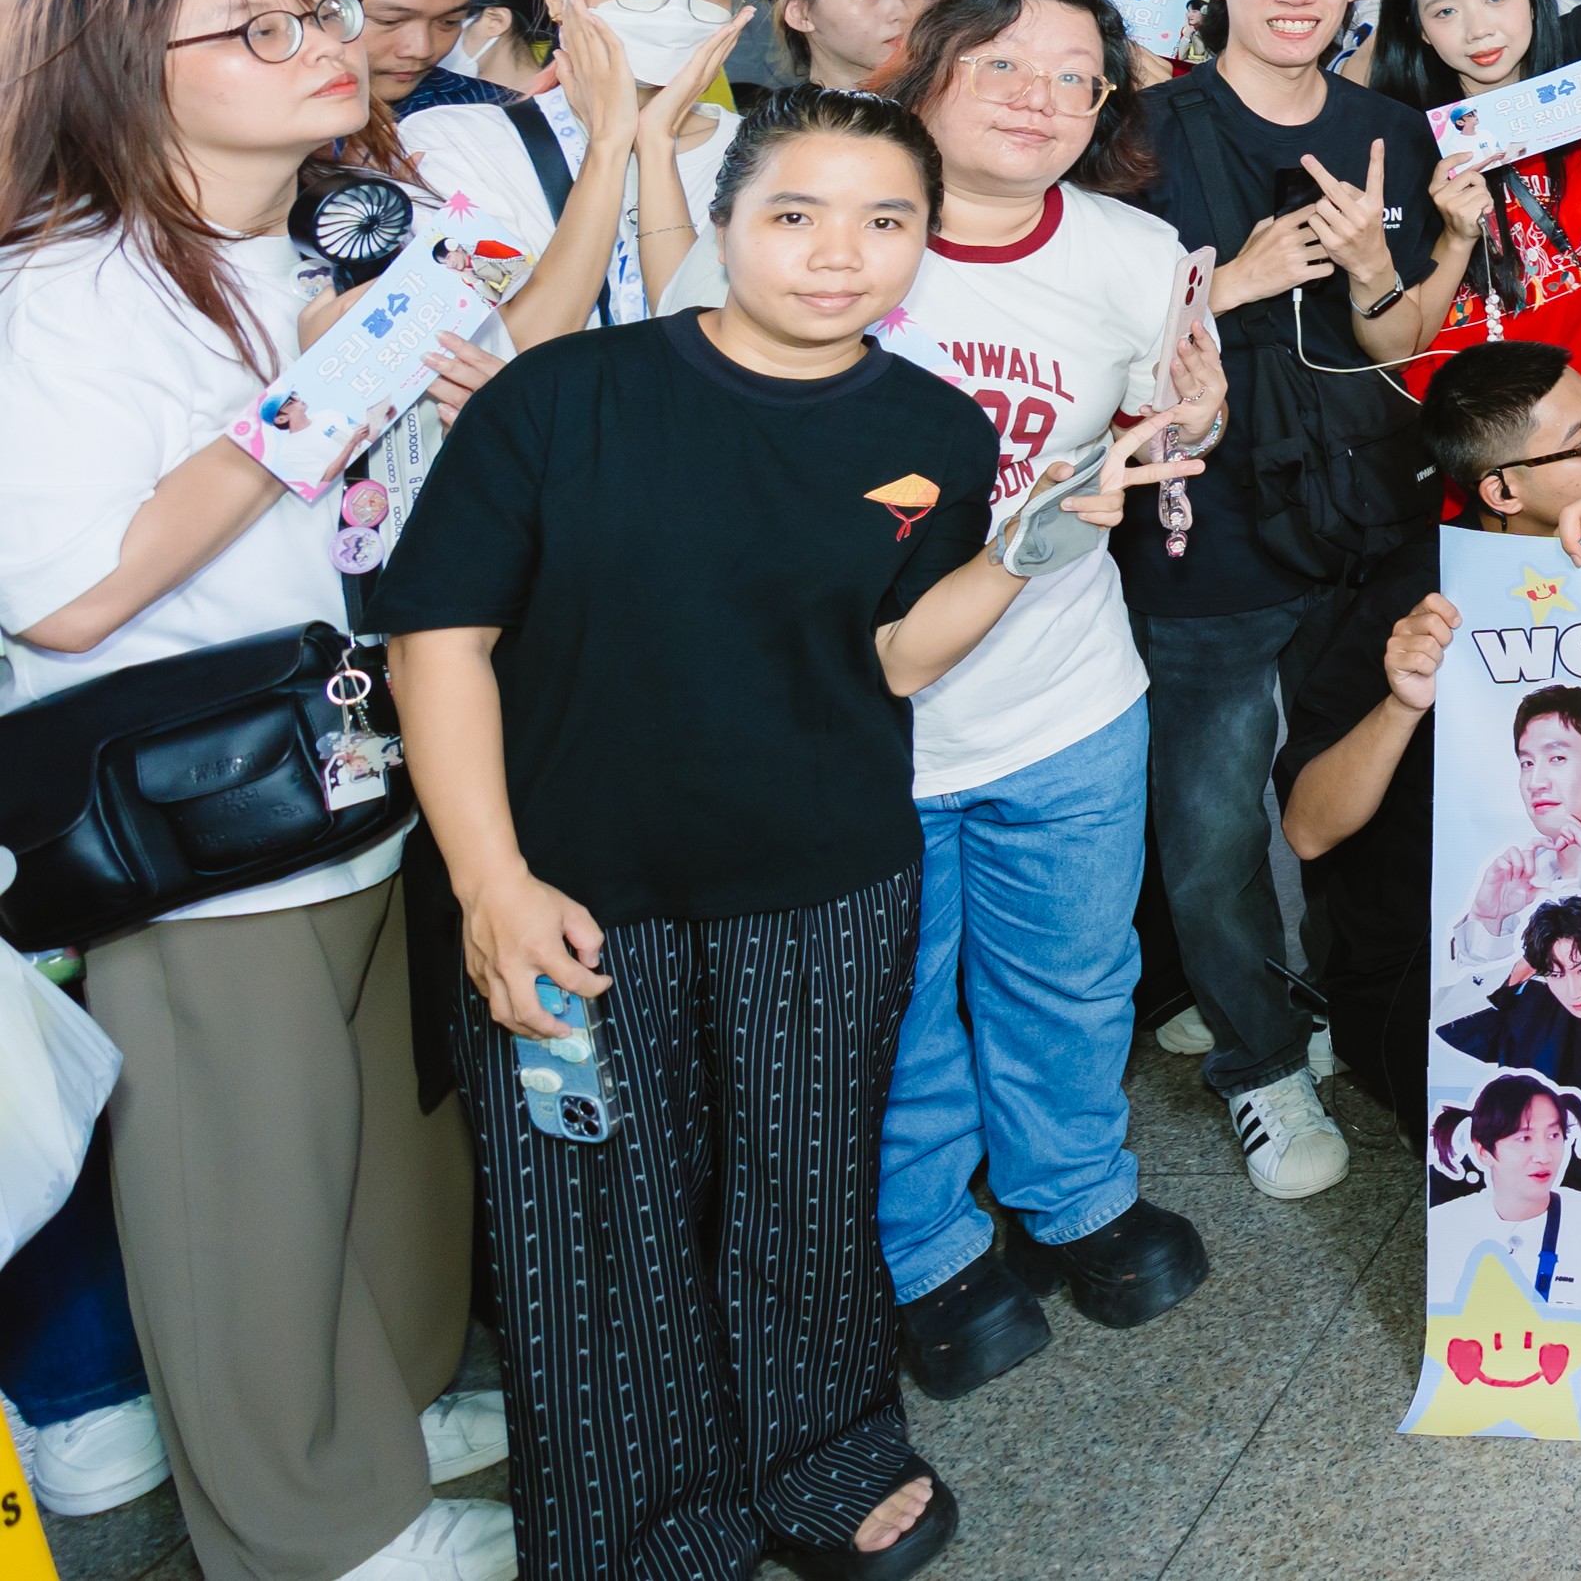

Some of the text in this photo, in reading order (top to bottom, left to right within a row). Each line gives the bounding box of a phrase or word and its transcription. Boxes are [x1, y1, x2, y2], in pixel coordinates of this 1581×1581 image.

[1495, 92, 1534, 116] 우리
[1509, 119, 1530, 137] 또
[318, 270, 428, 385] 우리 광수가
[350, 366, 384, 399] 또
[376, 293, 452, 372] 왔어요!
[938, 341, 1075, 403] NWALL
